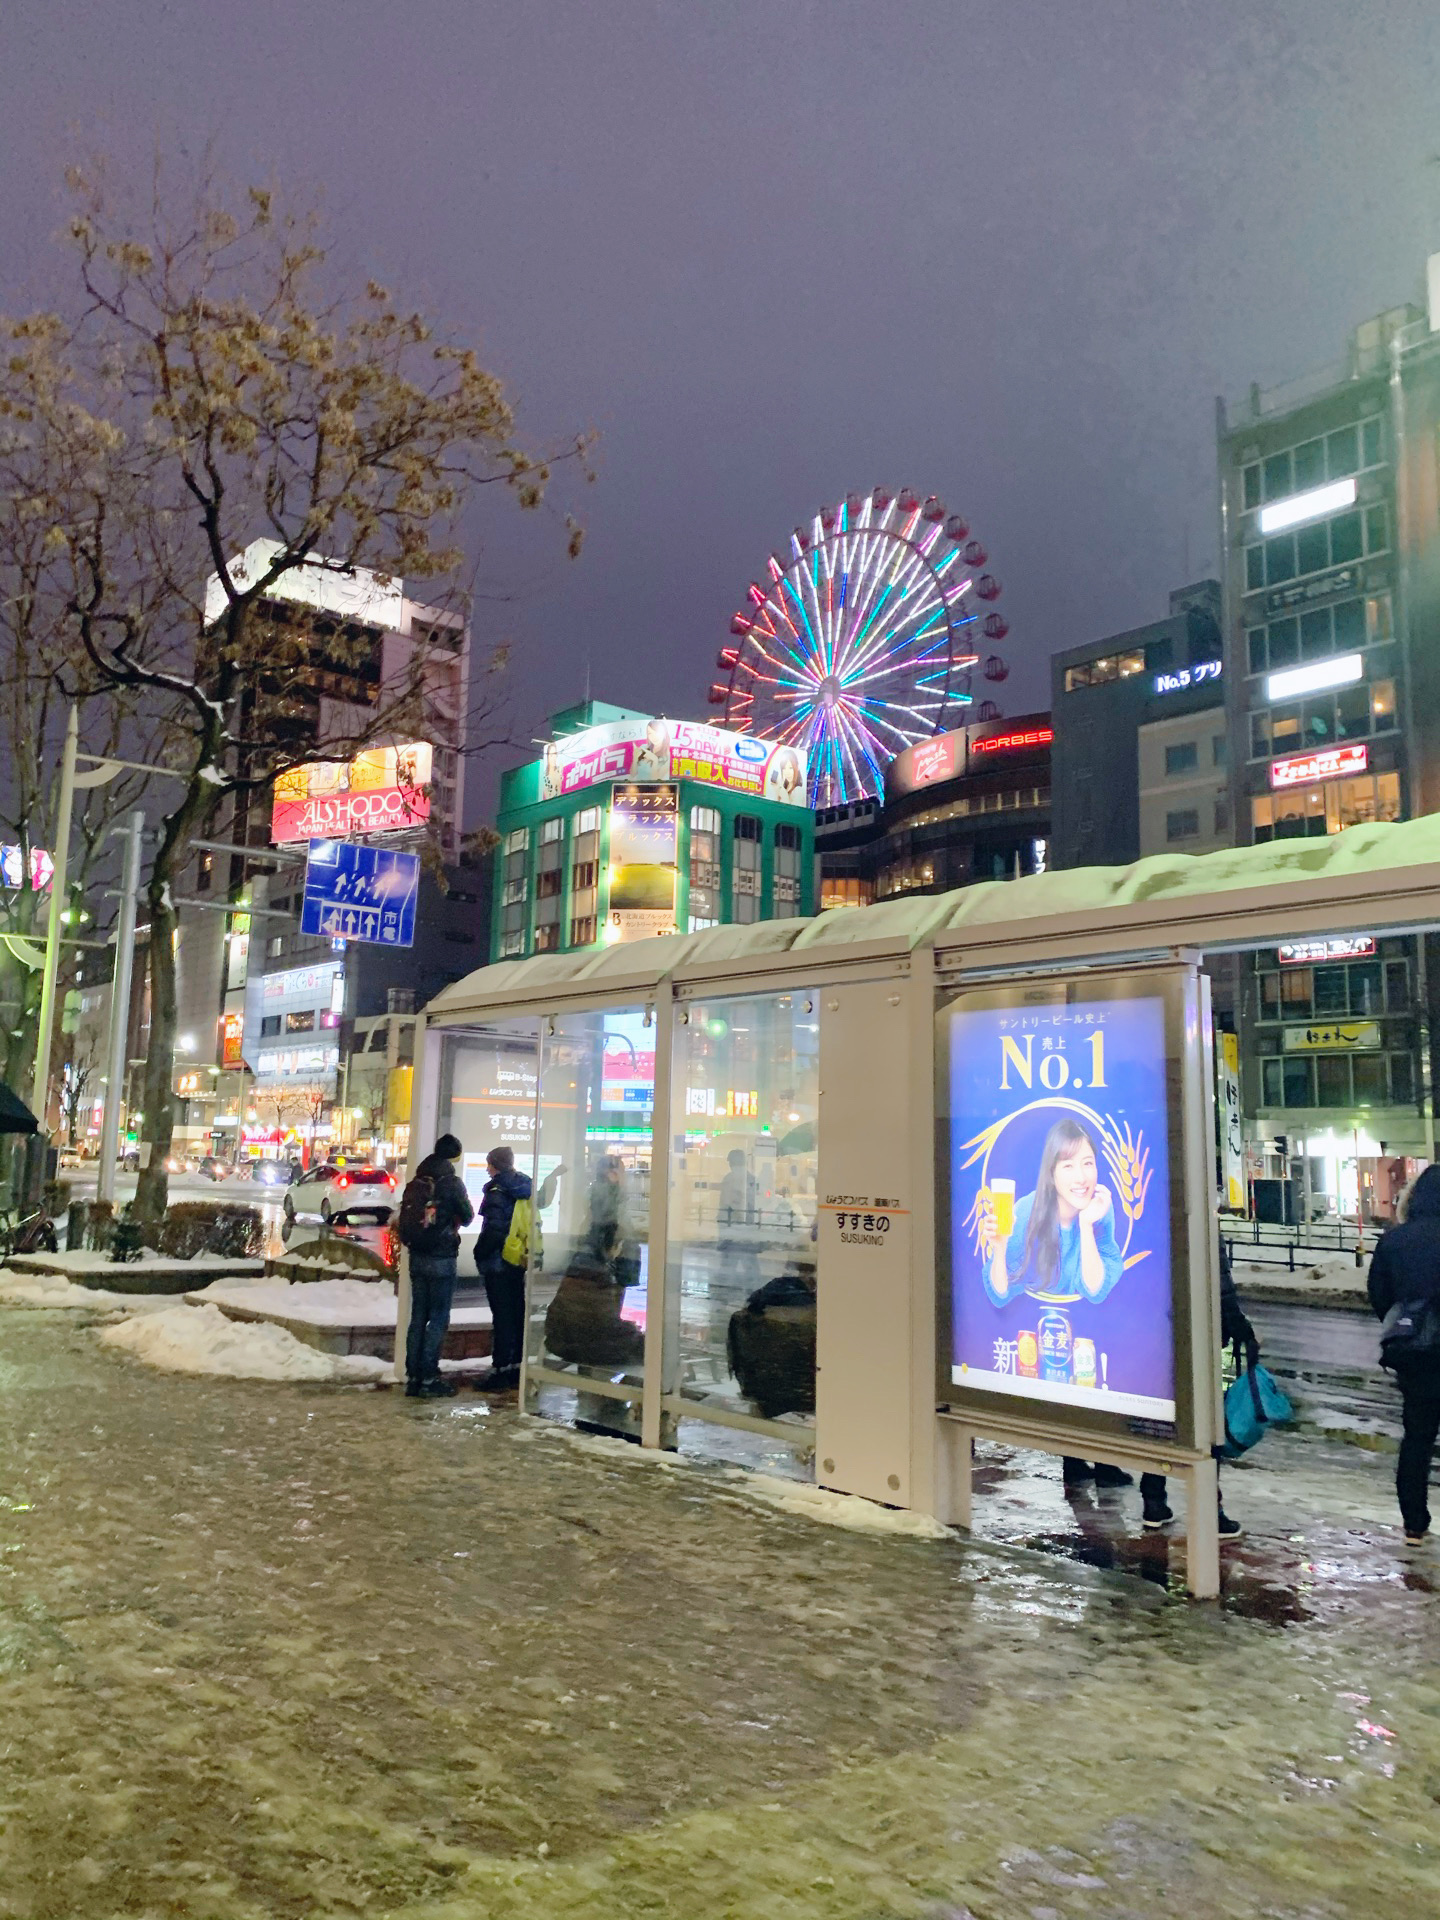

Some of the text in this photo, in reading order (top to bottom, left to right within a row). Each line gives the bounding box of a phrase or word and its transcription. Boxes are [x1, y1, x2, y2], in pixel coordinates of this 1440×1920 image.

[1157, 670, 1190, 692] No.5
[565, 748, 626, 788] ポケパラ
[679, 757, 727, 784] 高収入
[615, 796, 675, 807] デラックス
[296, 822, 322, 836] JAPAN
[368, 812, 403, 828] BEAUTY
[618, 814, 675, 825] ラックス
[626, 912, 673, 920] 北海道ブルックス
[999, 1013, 1107, 1030] サントリービール史上
[1042, 1036, 1066, 1050] 売上
[998, 1030, 1108, 1090] No.1
[489, 1114, 543, 1130] すすきの
[501, 1133, 531, 1141] SUSUKINO
[835, 1212, 891, 1232] すすきの
[840, 1232, 884, 1246] SUSUKINO
[1042, 1329, 1069, 1350] 金麦
[993, 1336, 1018, 1376] 新
